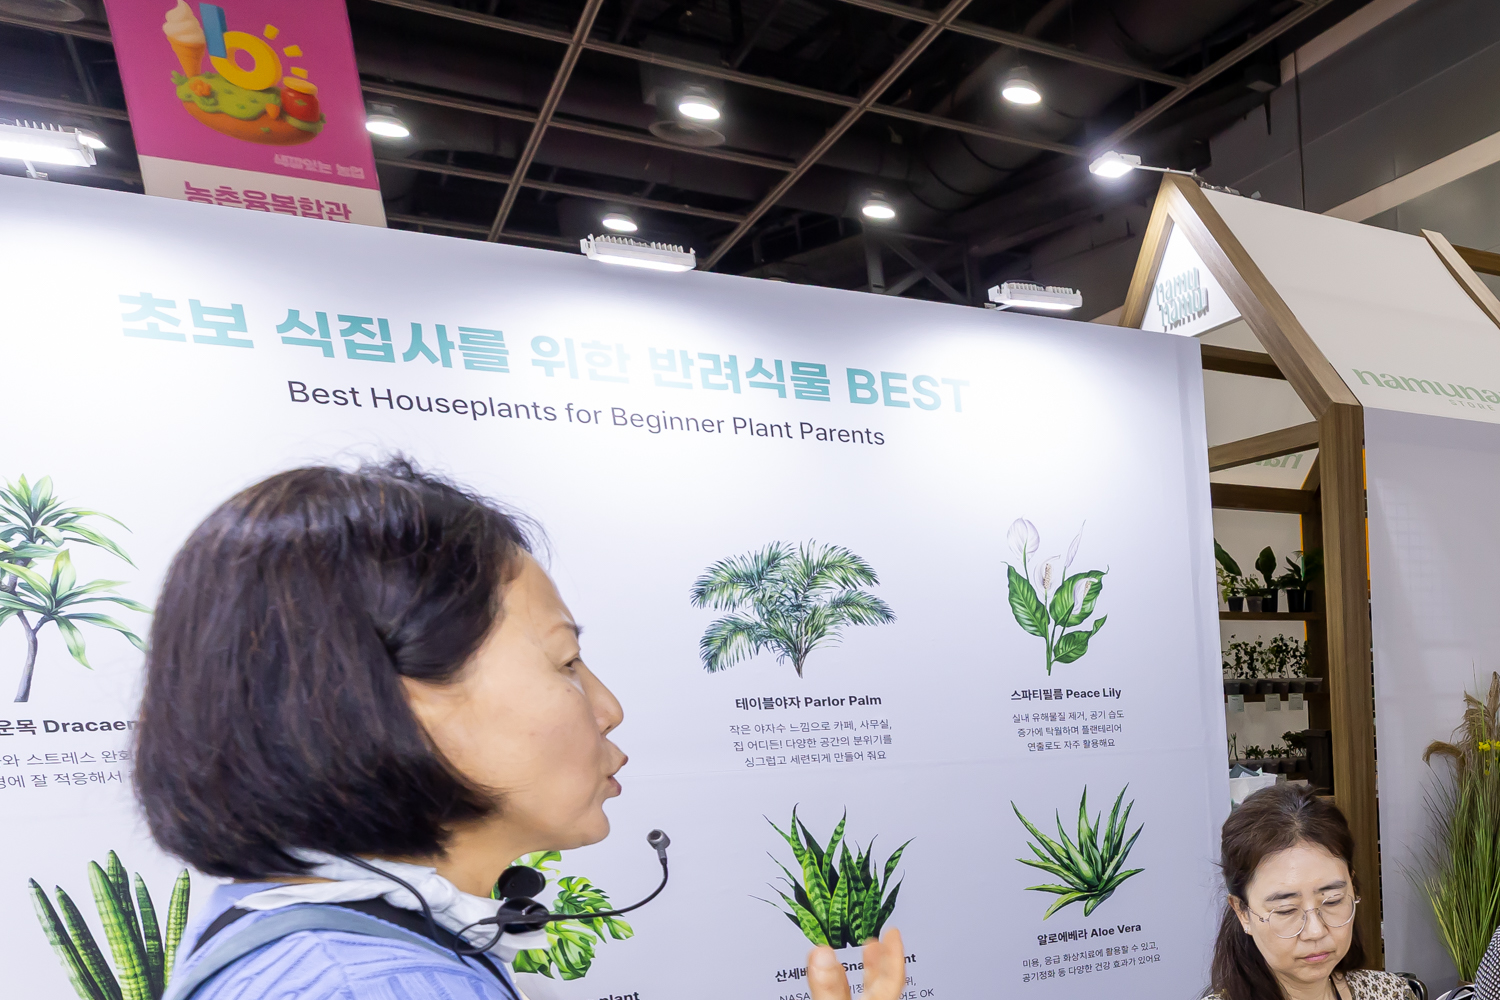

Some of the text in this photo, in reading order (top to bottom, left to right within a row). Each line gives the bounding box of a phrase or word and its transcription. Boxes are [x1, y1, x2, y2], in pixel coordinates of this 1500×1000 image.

[119, 291, 970, 413] 초보 식집사를 위한 반려식물 BEST
[287, 380, 886, 446] Best Houseplants for Beginner Plant Parents
[1449, 399, 1496, 412] STORE
[1010, 687, 1122, 701] 스파티필름 Peace Lily
[735, 695, 882, 711] 테이블야자 Parlor Palm
[1012, 709, 1125, 724] 실내 유해물질 제거, 공기 습도
[729, 718, 893, 735] 작은 야자수 느낌으로 카페, 사무실,
[1017, 724, 1122, 738] 증가에 탁월하며 플랜테리어
[733, 734, 893, 752] 집 어디든! 다양한 공간의 분위기를
[1027, 738, 1115, 752] 연출로도 자주 활용해요
[26, 751, 97, 765] 스트레스
[744, 750, 887, 767] 싱그럽고 세련되게 만들어 줘요
[30, 773, 49, 788] 잘
[53, 770, 123, 786] 적응해서
[1037, 924, 1142, 946] 알로에베라 Aloe Vera
[1022, 941, 1159, 968] 미용, 응급 화상치료에 활용할 수 있고,
[1022, 953, 1161, 983] 공기정화 등 다양한 건강 효과가 있어요
[919, 987, 935, 999] OK
